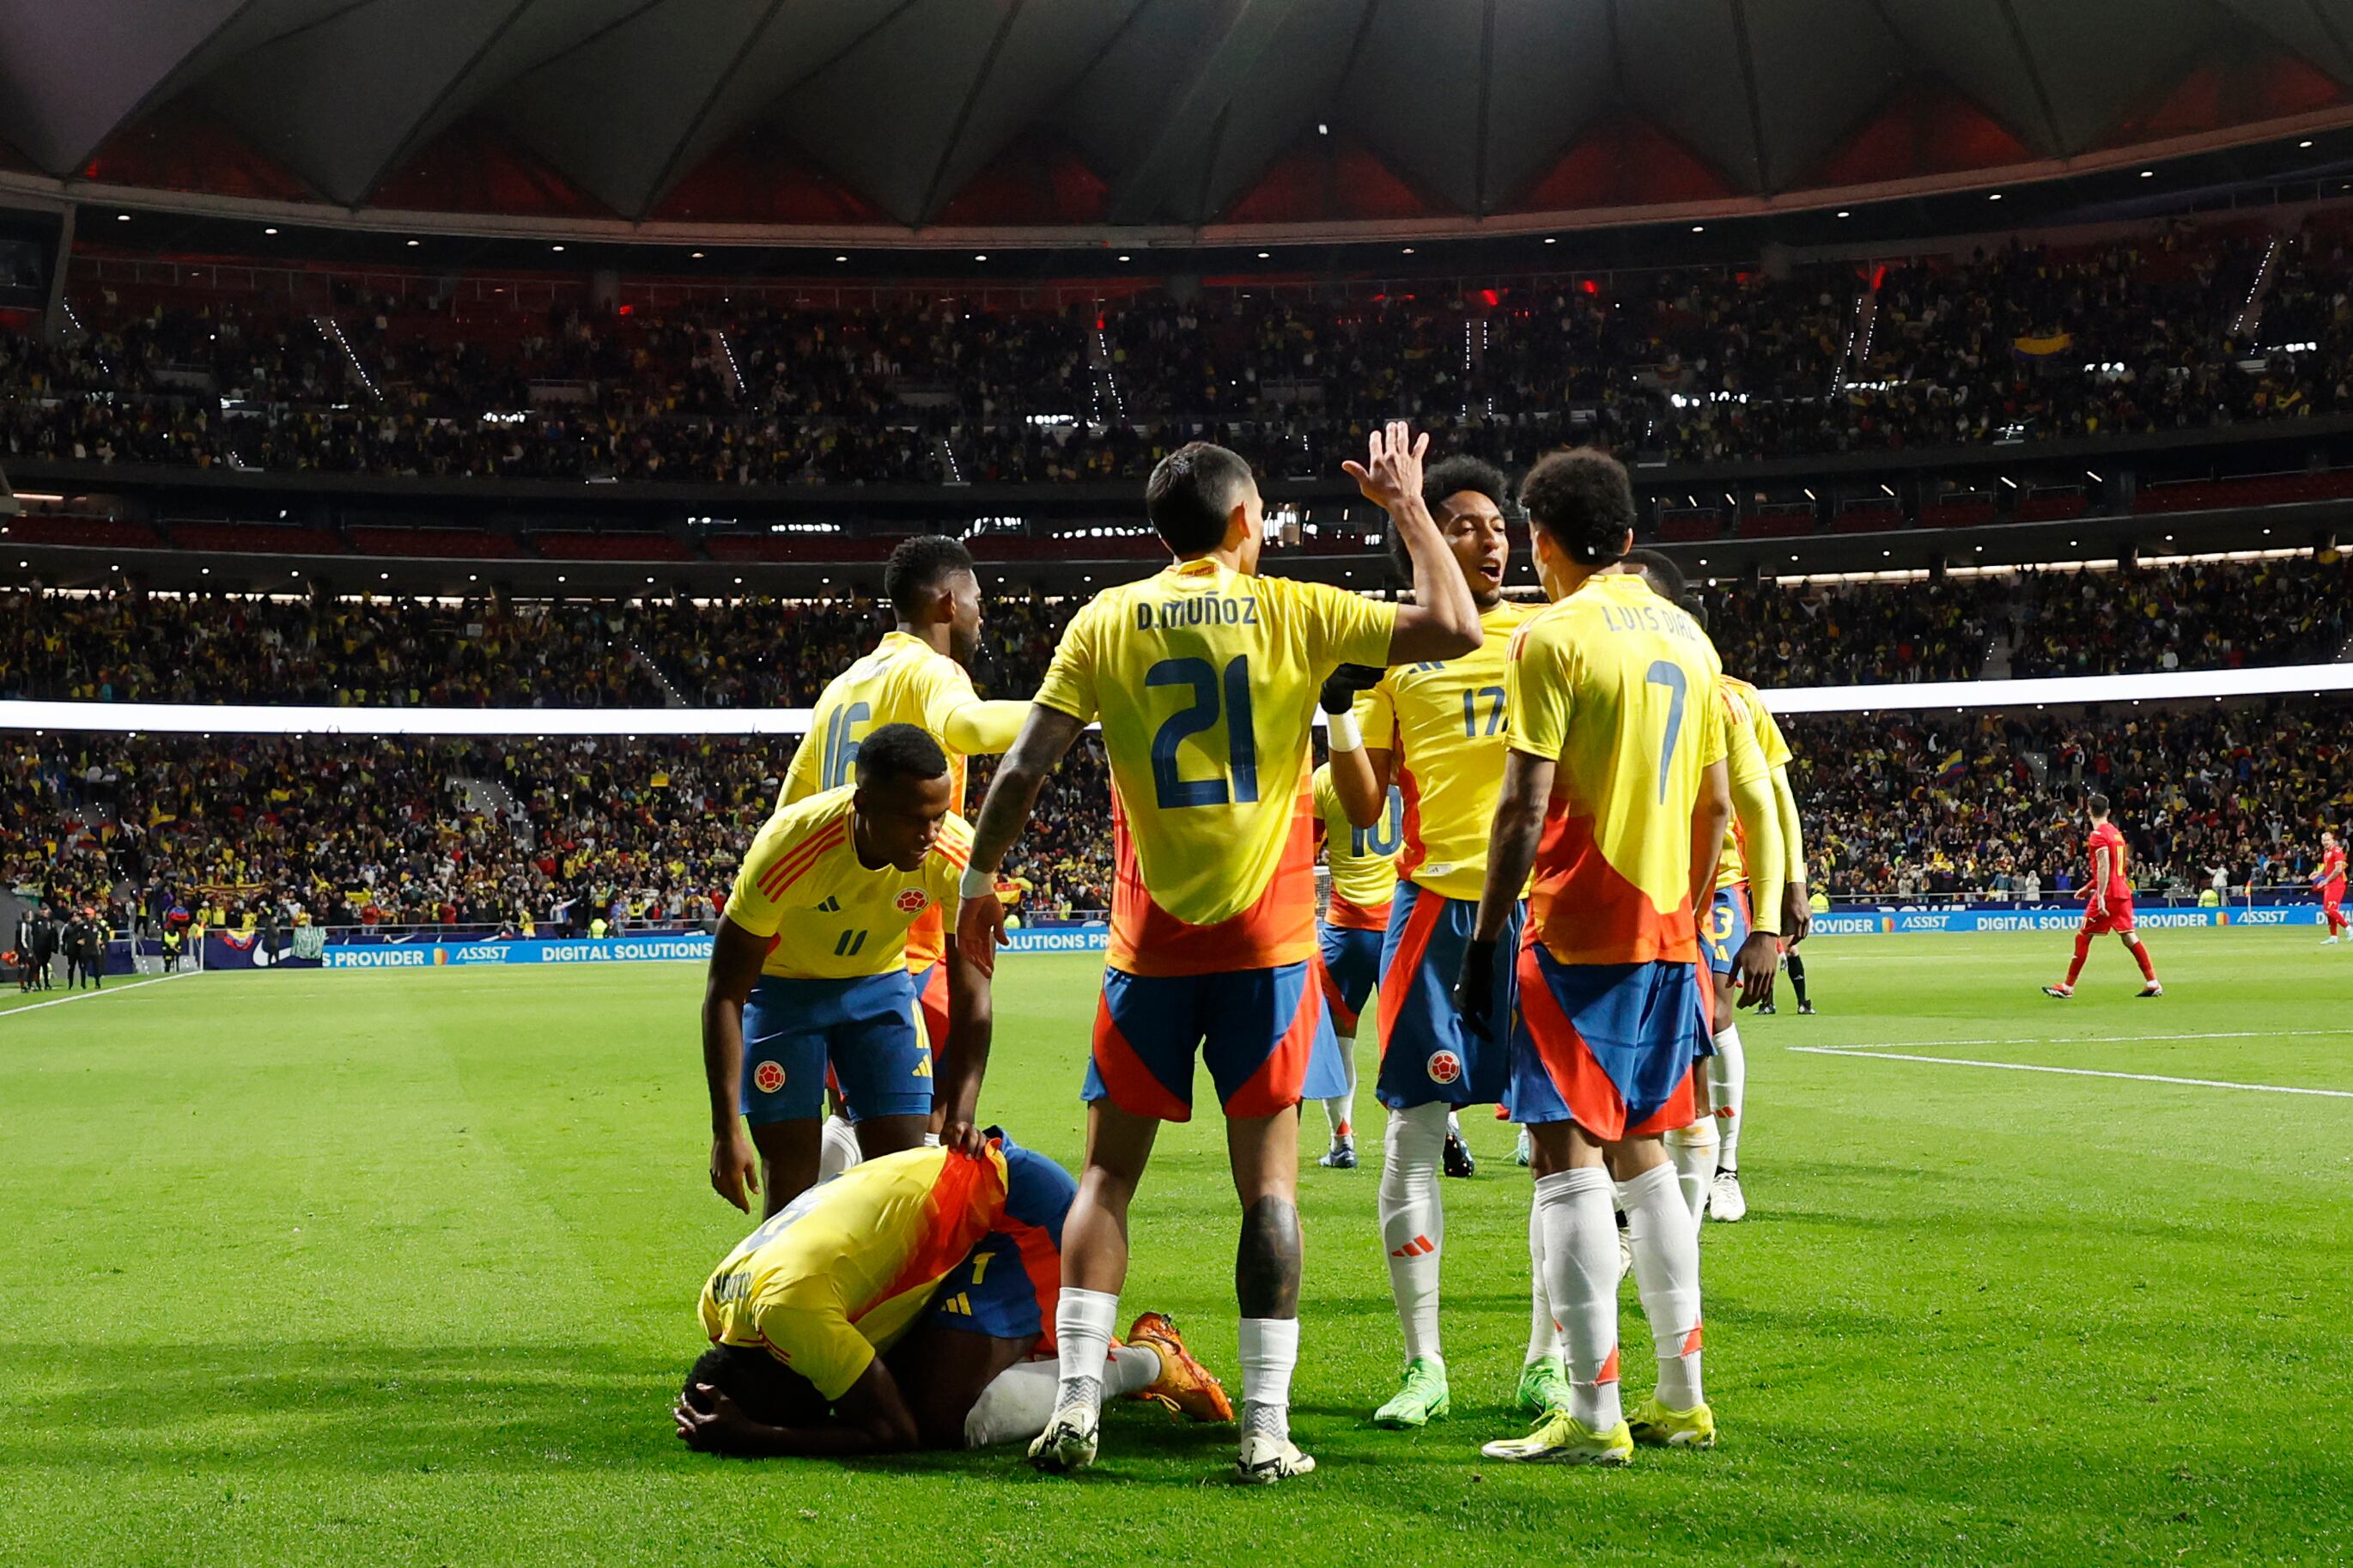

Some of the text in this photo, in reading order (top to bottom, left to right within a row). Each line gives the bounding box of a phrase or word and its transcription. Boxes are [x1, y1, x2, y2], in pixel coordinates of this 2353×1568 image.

[1137, 591, 1257, 630] D.MUÑOZ
[1602, 606, 1660, 632] LUIS
[1463, 686, 1505, 737] 17
[1145, 654, 1259, 809] 21
[1646, 659, 1687, 805] 7
[1901, 915, 1950, 928] ASSIST
[1977, 916, 2037, 930] DIGITAL
[2132, 914, 2208, 927] PROVIDER
[2236, 910, 2289, 923] ASSIST
[834, 929, 867, 956] 11
[996, 934, 1085, 950] OLUTIONS
[336, 951, 424, 966] PROVIDER
[456, 945, 511, 960] ASSIST
[542, 943, 713, 961] DIGITAL SOLUTIONS
